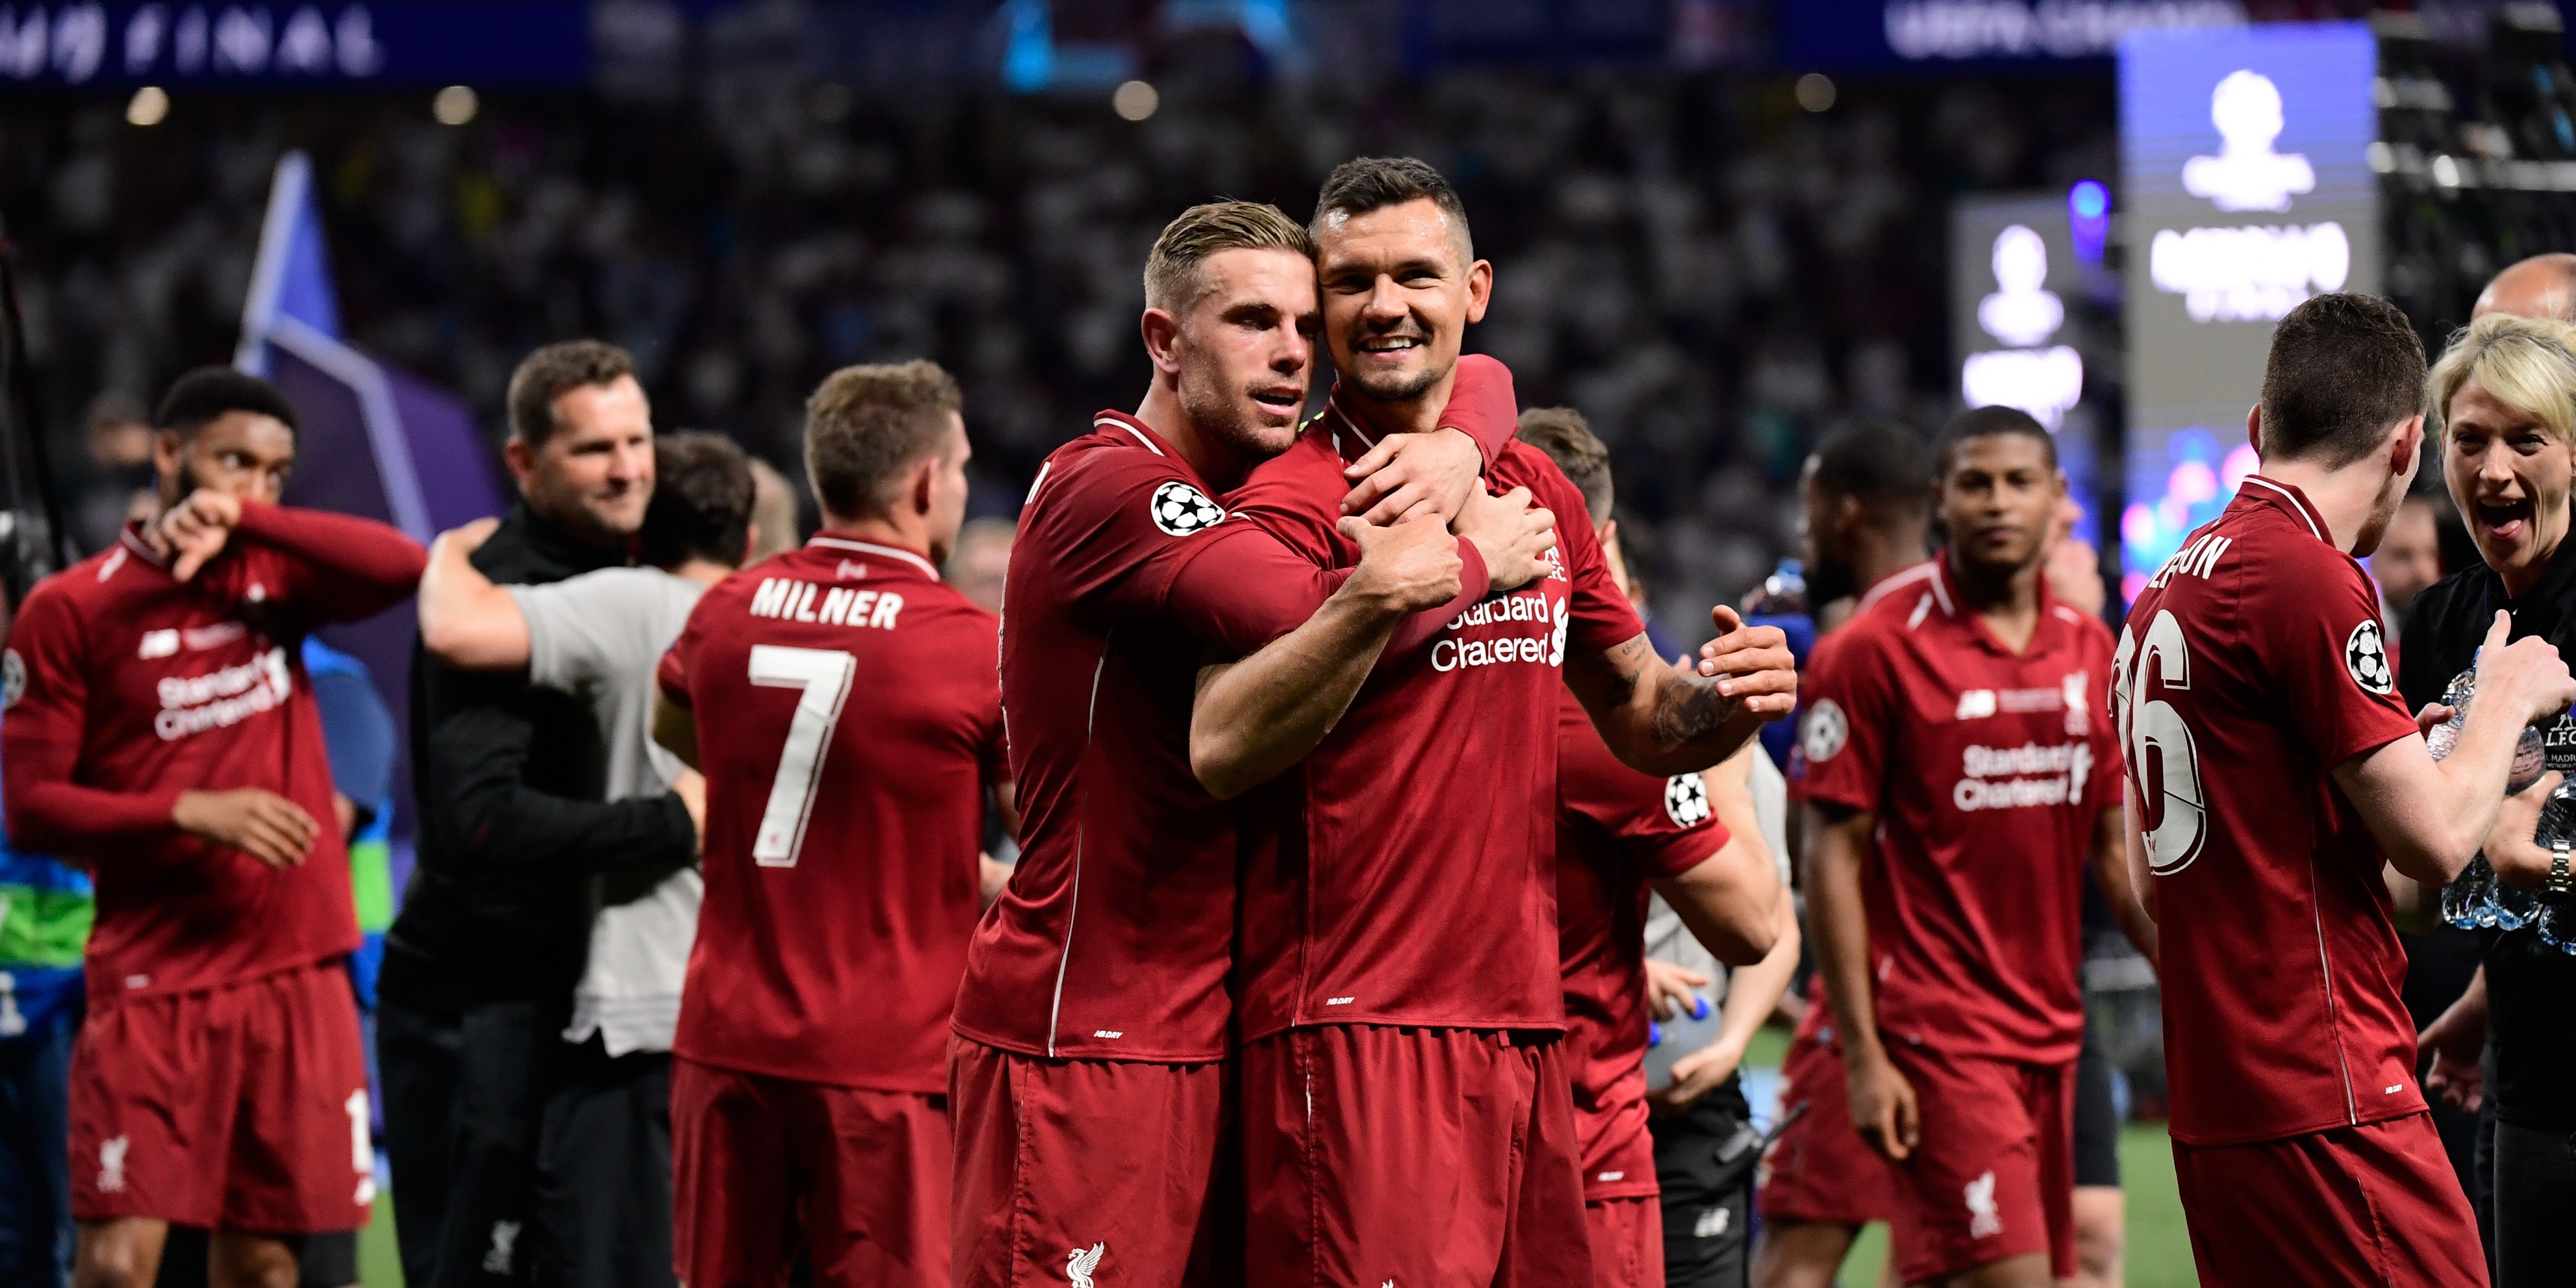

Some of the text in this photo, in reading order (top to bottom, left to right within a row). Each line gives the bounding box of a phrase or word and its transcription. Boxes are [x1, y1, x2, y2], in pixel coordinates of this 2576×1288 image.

[749, 577, 904, 630] MILNER
[748, 644, 857, 868] 7
[2107, 609, 2206, 876] 26
[1336, 997, 1355, 1005] DRY
[1105, 1031, 1123, 1039] DRY
